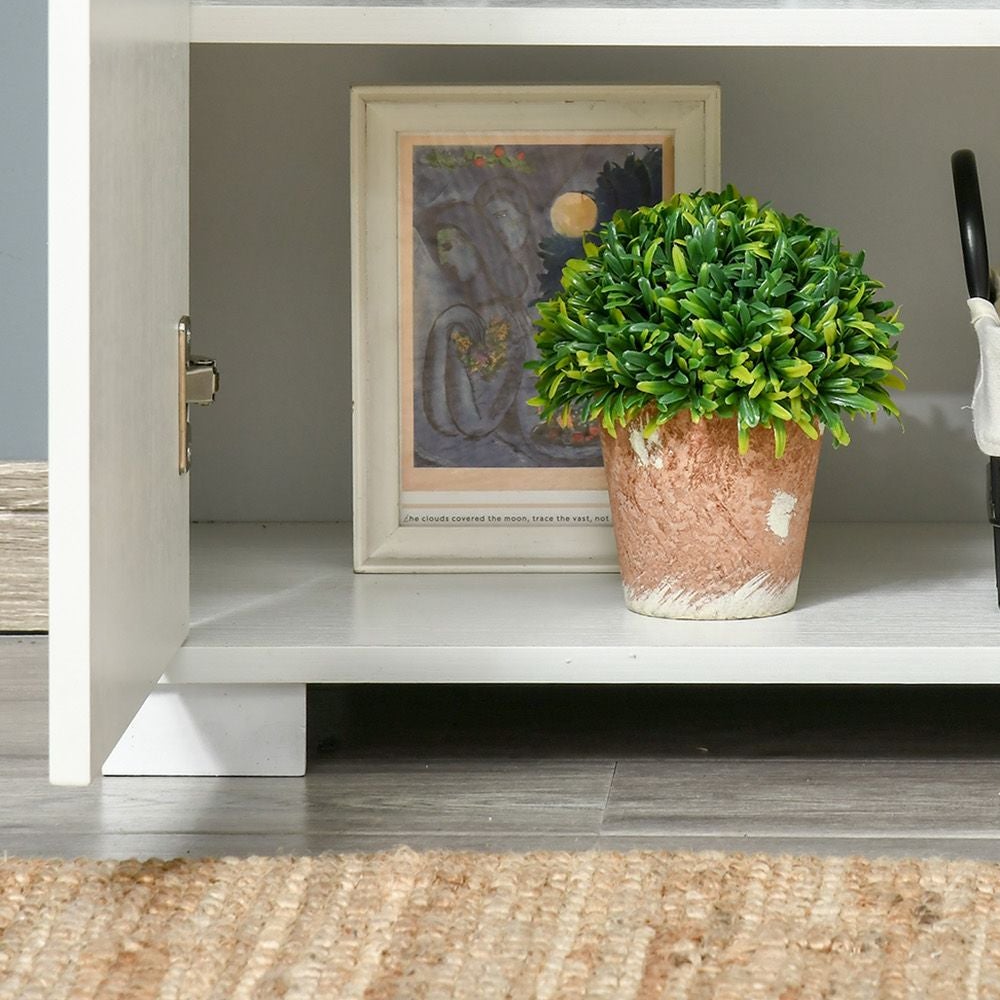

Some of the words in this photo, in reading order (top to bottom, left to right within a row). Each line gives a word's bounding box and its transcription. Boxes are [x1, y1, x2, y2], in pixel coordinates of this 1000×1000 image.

[421, 514, 449, 523] clouds
[451, 514, 486, 523] covered
[487, 514, 502, 523] the
[503, 515, 530, 524] moon,
[532, 515, 554, 523] trace
[556, 514, 570, 523] the
[572, 515, 593, 524] vast,
[594, 515, 610, 523] not
